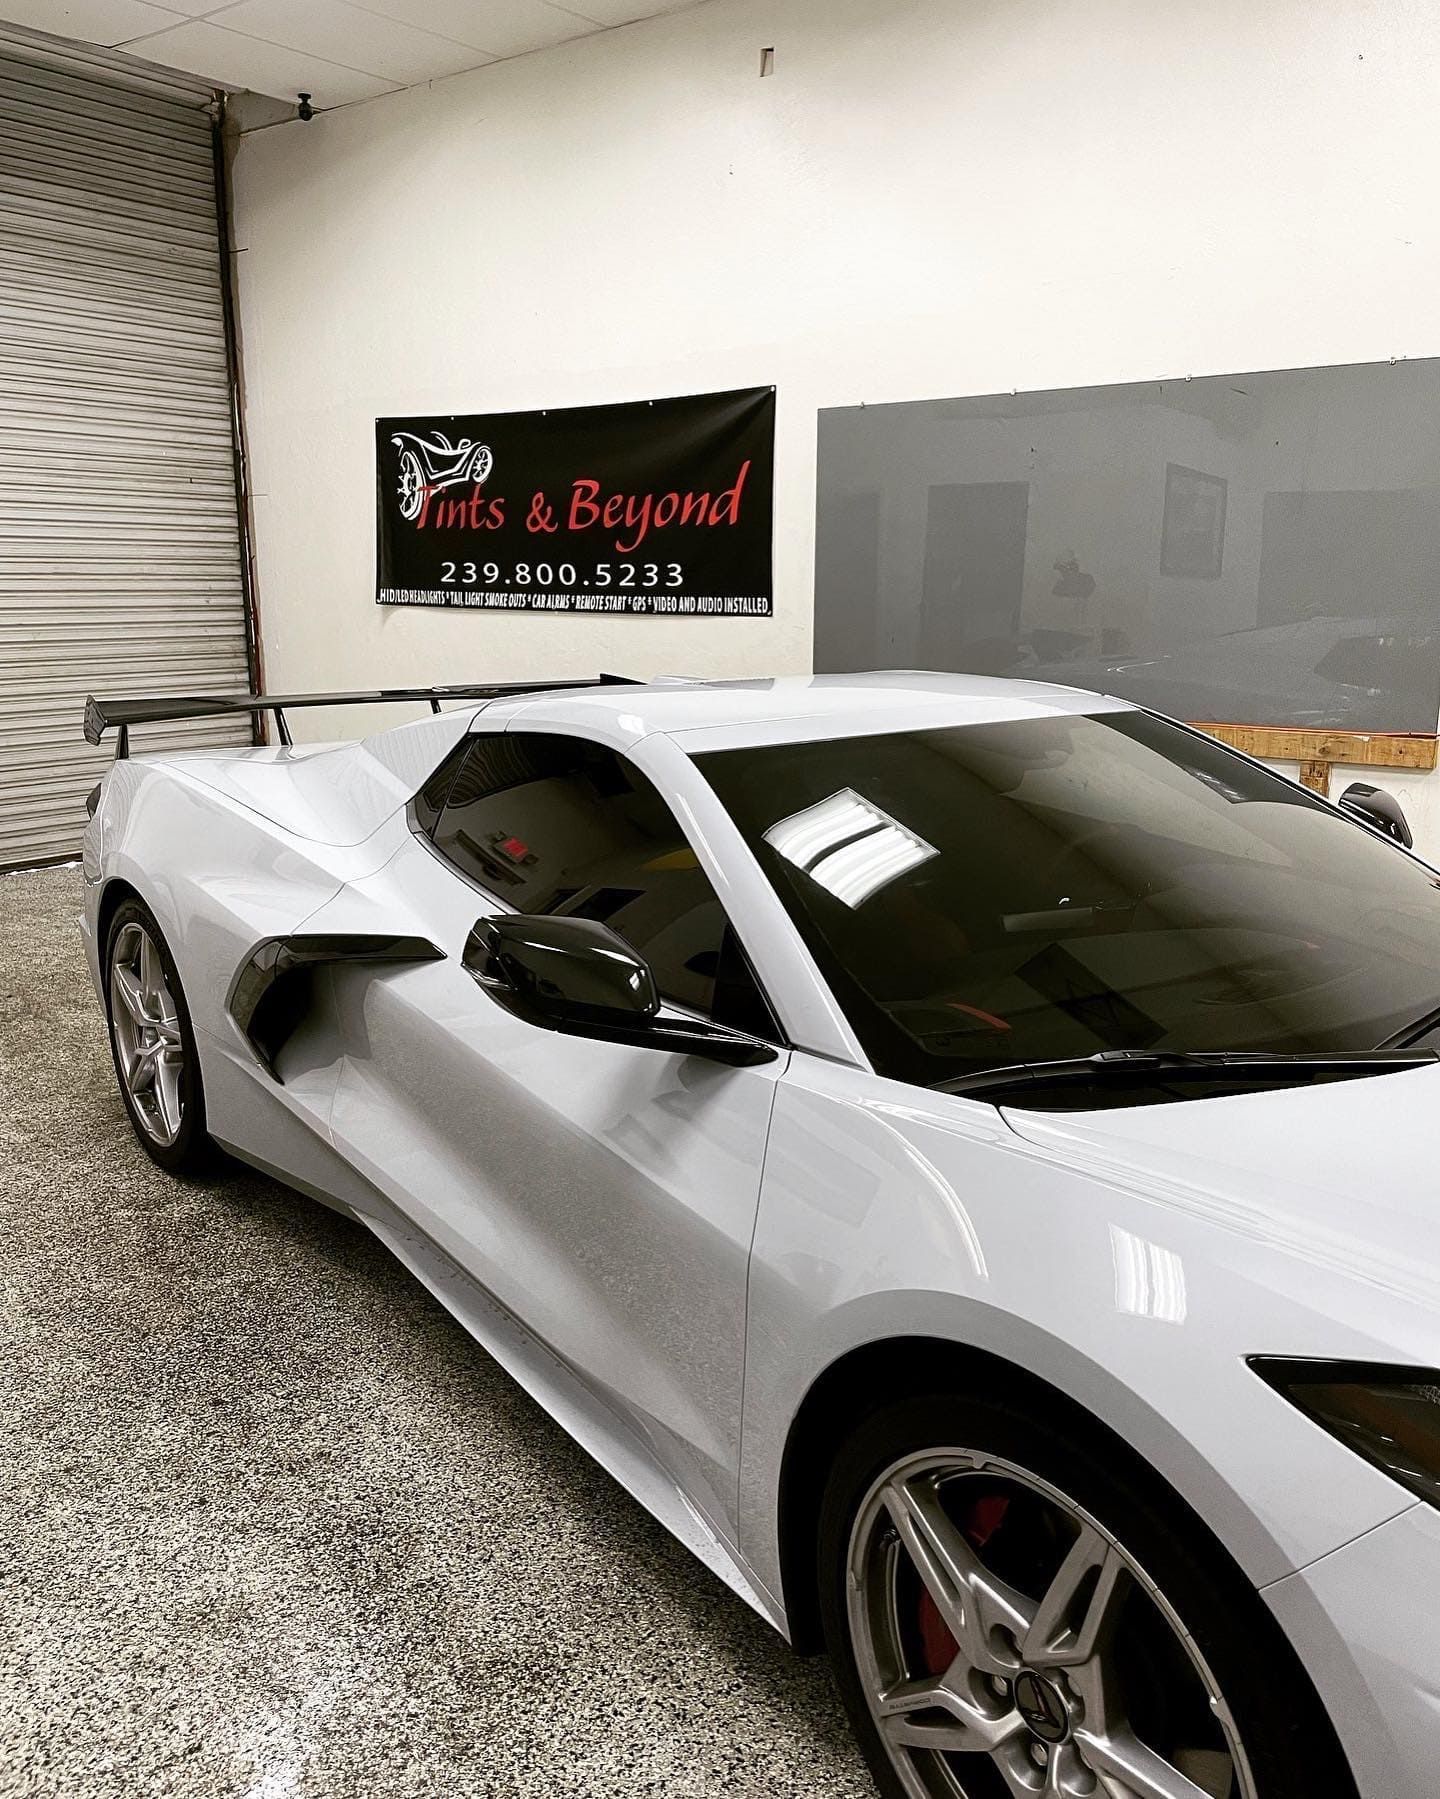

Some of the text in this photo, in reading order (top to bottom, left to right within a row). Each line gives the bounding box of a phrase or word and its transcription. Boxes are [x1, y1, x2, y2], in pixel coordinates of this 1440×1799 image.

[416, 459, 751, 553] Tints & Beyond
[440, 561, 684, 587] 239.800.5233
[450, 591, 464, 605] TAIL
[465, 591, 484, 606] LIGHT
[485, 592, 508, 607] SMOKE
[508, 593, 527, 608] OUTS
[532, 593, 546, 609] CAR
[575, 594, 605, 610] REMOTE
[604, 595, 627, 611] START
[632, 596, 647, 611] GPS
[653, 596, 677, 612] VIDEO
[678, 596, 696, 612] AND
[697, 597, 723, 613] AUDIO
[724, 597, 769, 614] INSTALLED
